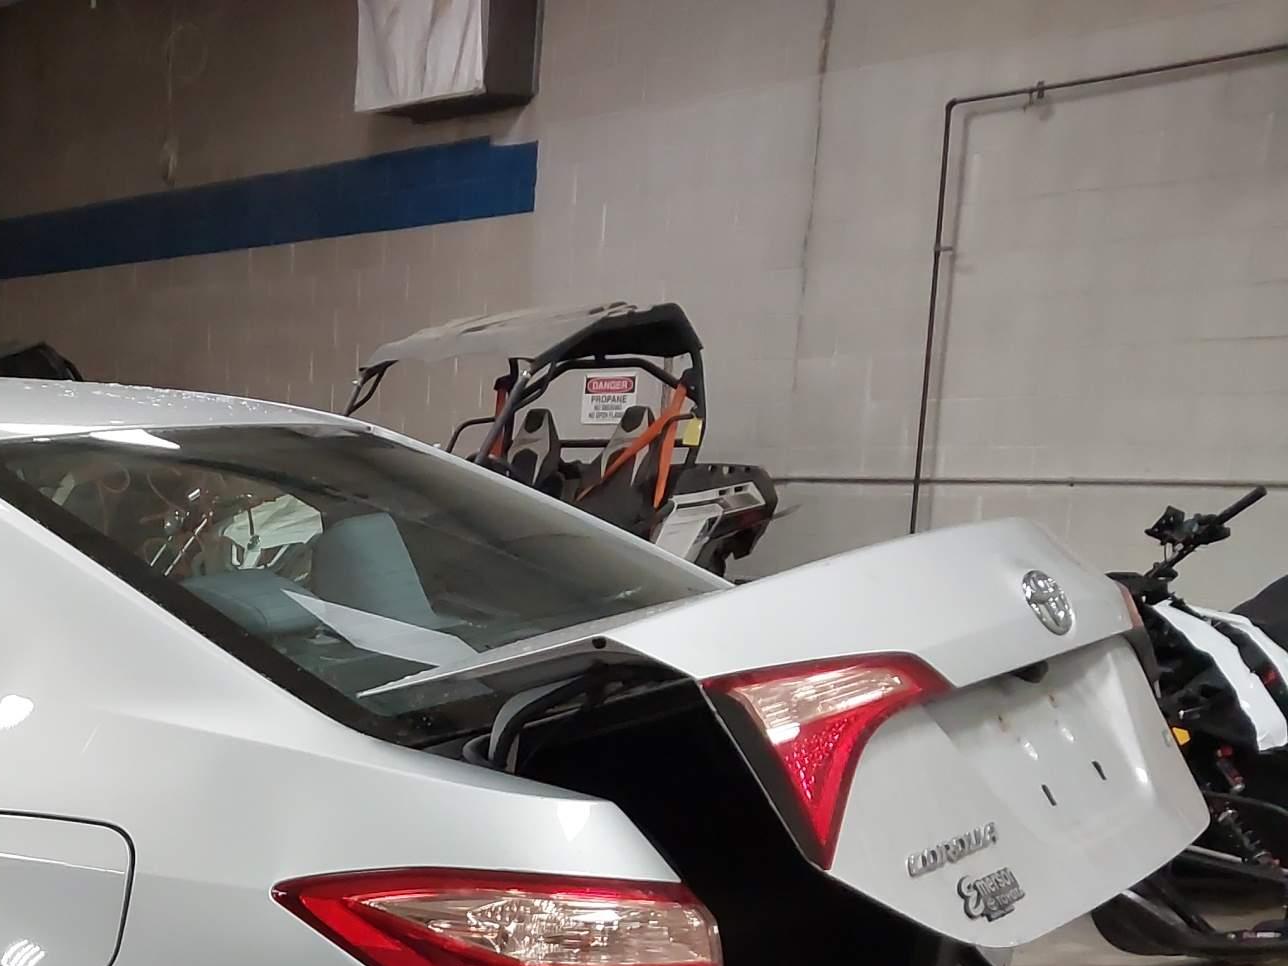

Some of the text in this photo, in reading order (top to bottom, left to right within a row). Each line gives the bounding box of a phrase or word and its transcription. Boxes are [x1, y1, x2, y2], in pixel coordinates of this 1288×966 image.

[592, 380, 628, 390] DANGER
[591, 395, 627, 404] PROPANE
[957, 868, 1018, 920] Emerson
